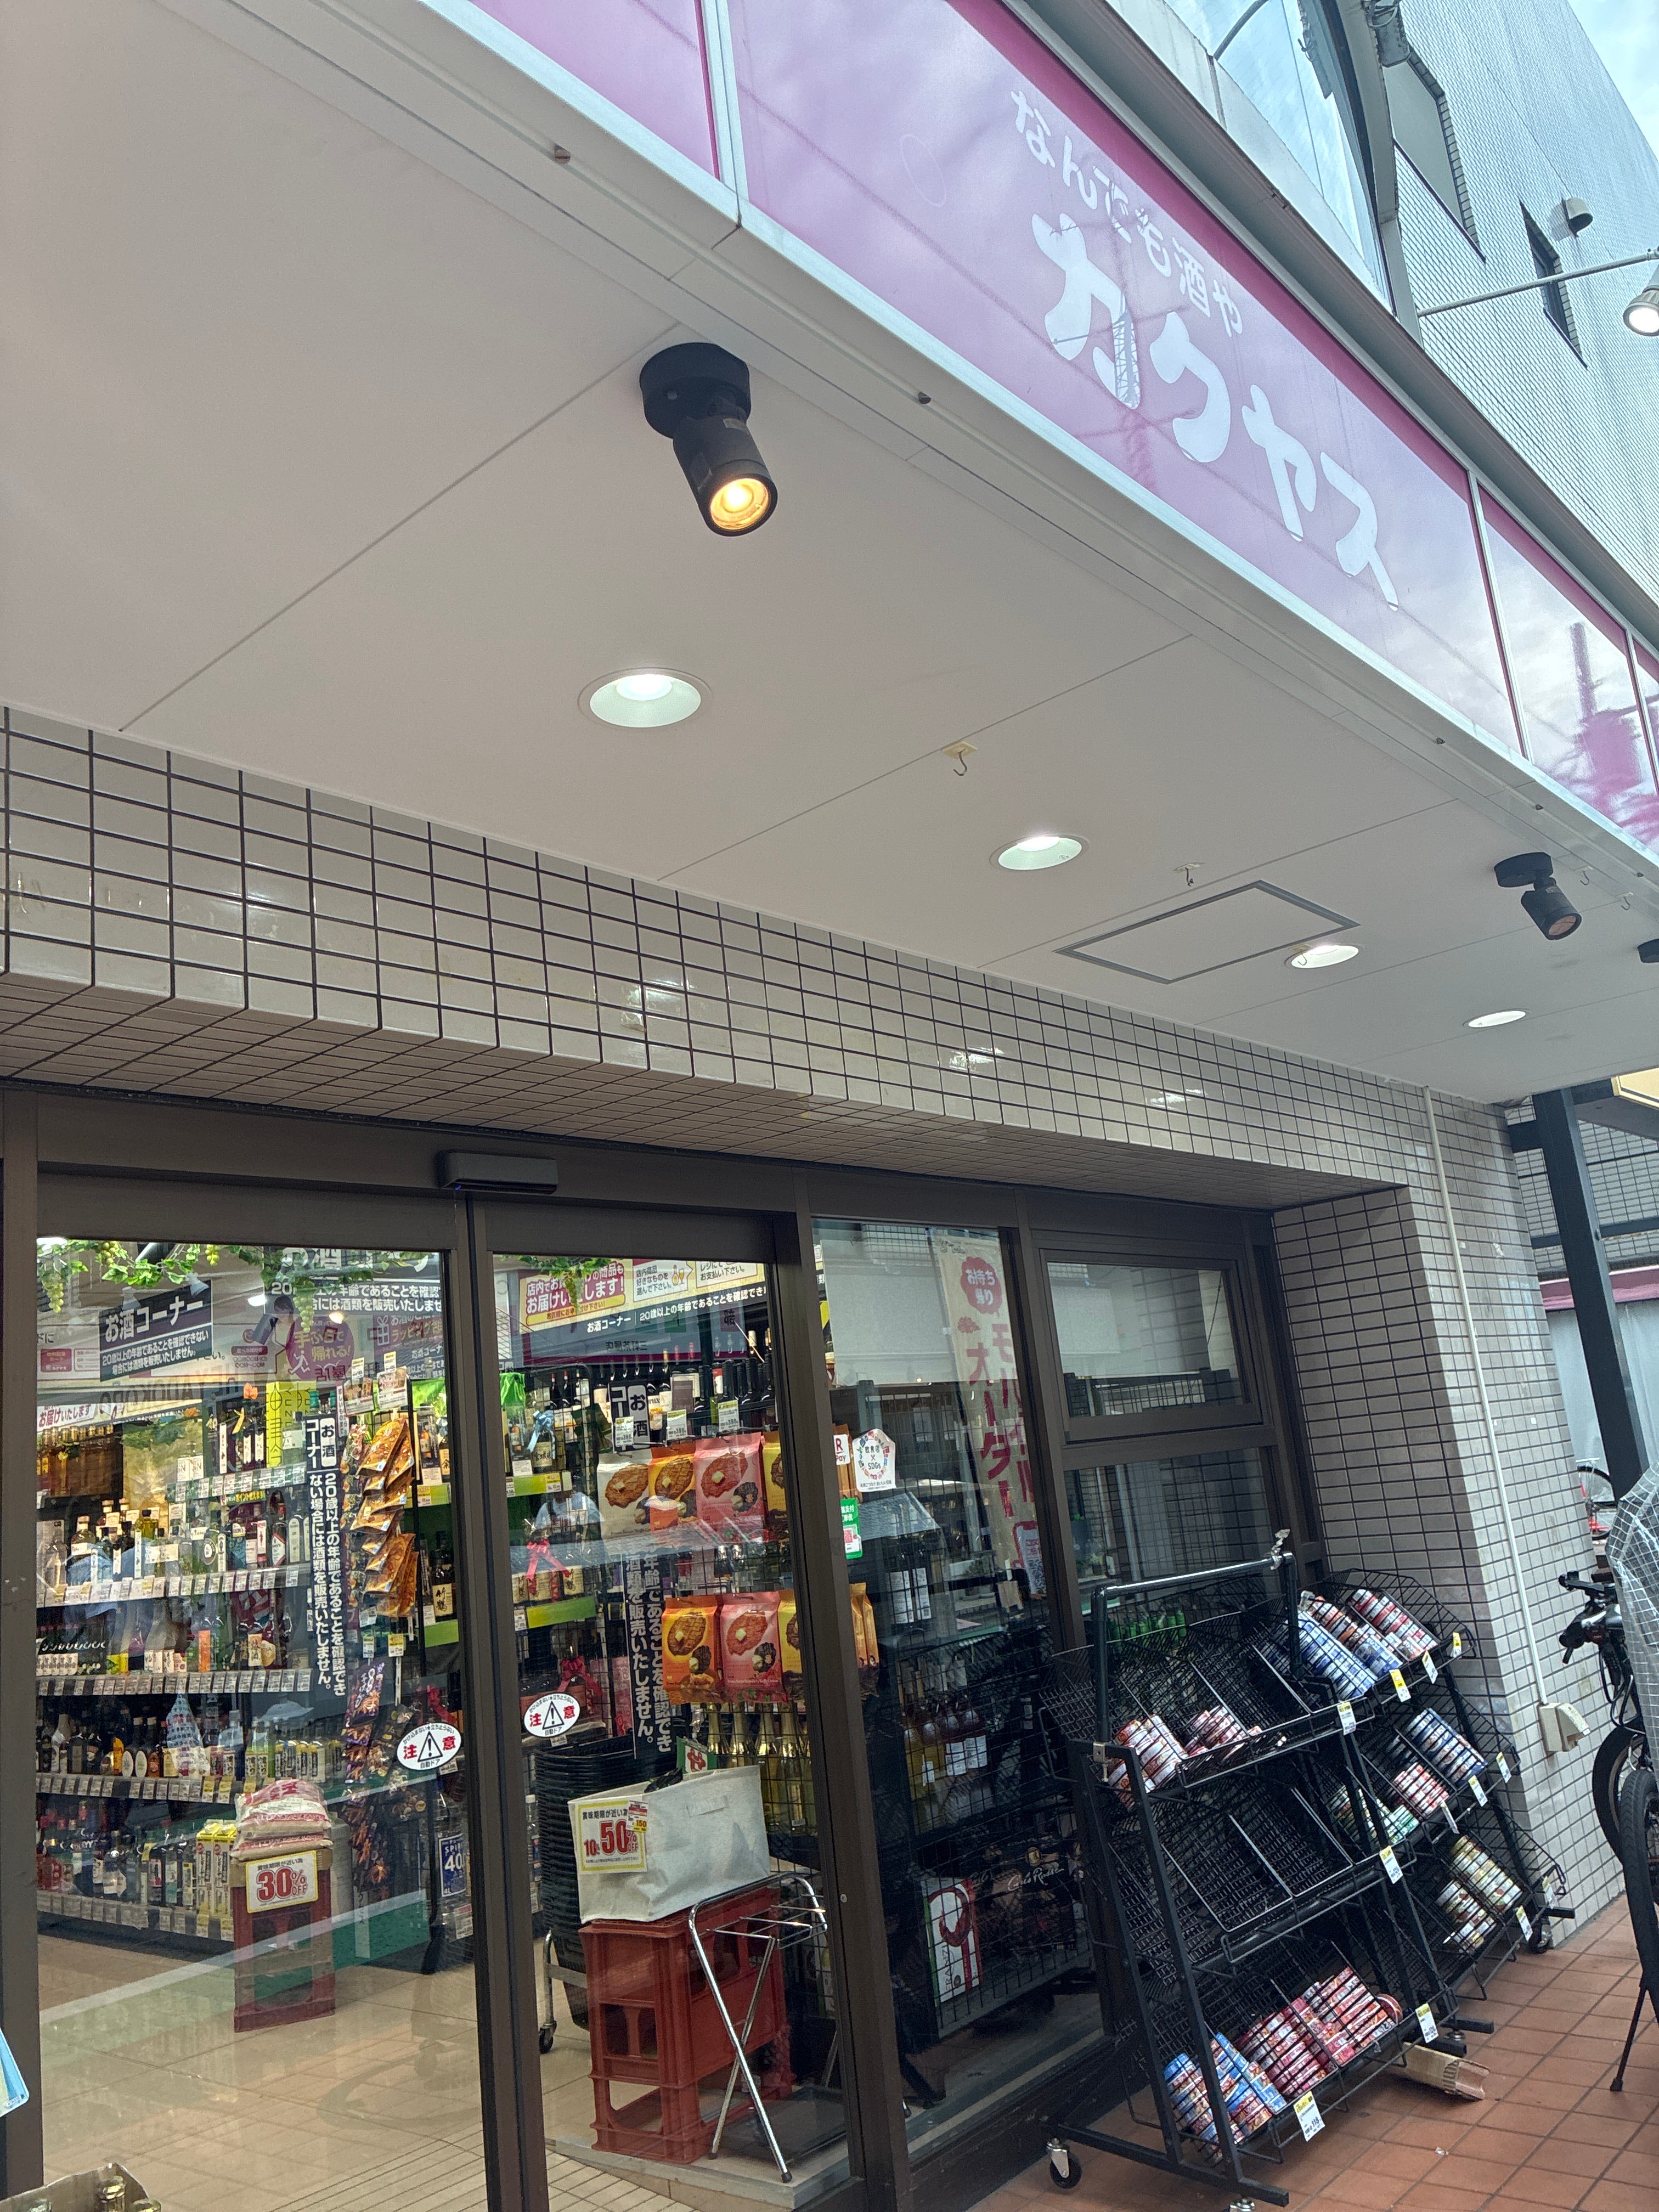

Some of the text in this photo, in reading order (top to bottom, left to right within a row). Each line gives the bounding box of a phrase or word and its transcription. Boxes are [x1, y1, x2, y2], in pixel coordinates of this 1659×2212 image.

[1011, 89, 1243, 338] なんでも酒や
[1031, 212, 1400, 612] カクヤス
[527, 1262, 624, 1296] 店内でおの商品も
[636, 1272, 669, 1286] 好きなものを
[700, 1263, 745, 1281] お支払い下さい。
[966, 1268, 995, 1286] お持ち
[527, 1276, 624, 1314] お届けいします!
[105, 1296, 203, 1342] お酒コーナー
[587, 1316, 631, 1333] お酒コーナー
[311, 1345, 351, 1362] 帰れる!
[38, 1404, 92, 1427] お届けいたします
[630, 1394, 648, 1437] お酒
[306, 1419, 321, 1469] コーナー
[321, 1424, 336, 1457] お酒
[865, 1445, 881, 1453] 飲食店
[868, 1462, 881, 1470] SDGs
[309, 1474, 331, 1690] ない場合には酒類を販売いたしません。
[325, 1472, 346, 1696] 20歳以上の年齢であることを確認でき
[545, 1726, 562, 1736] 自動ドア
[420, 1758, 441, 1769] 自動ドア
[291, 1884, 308, 1897] OFF
